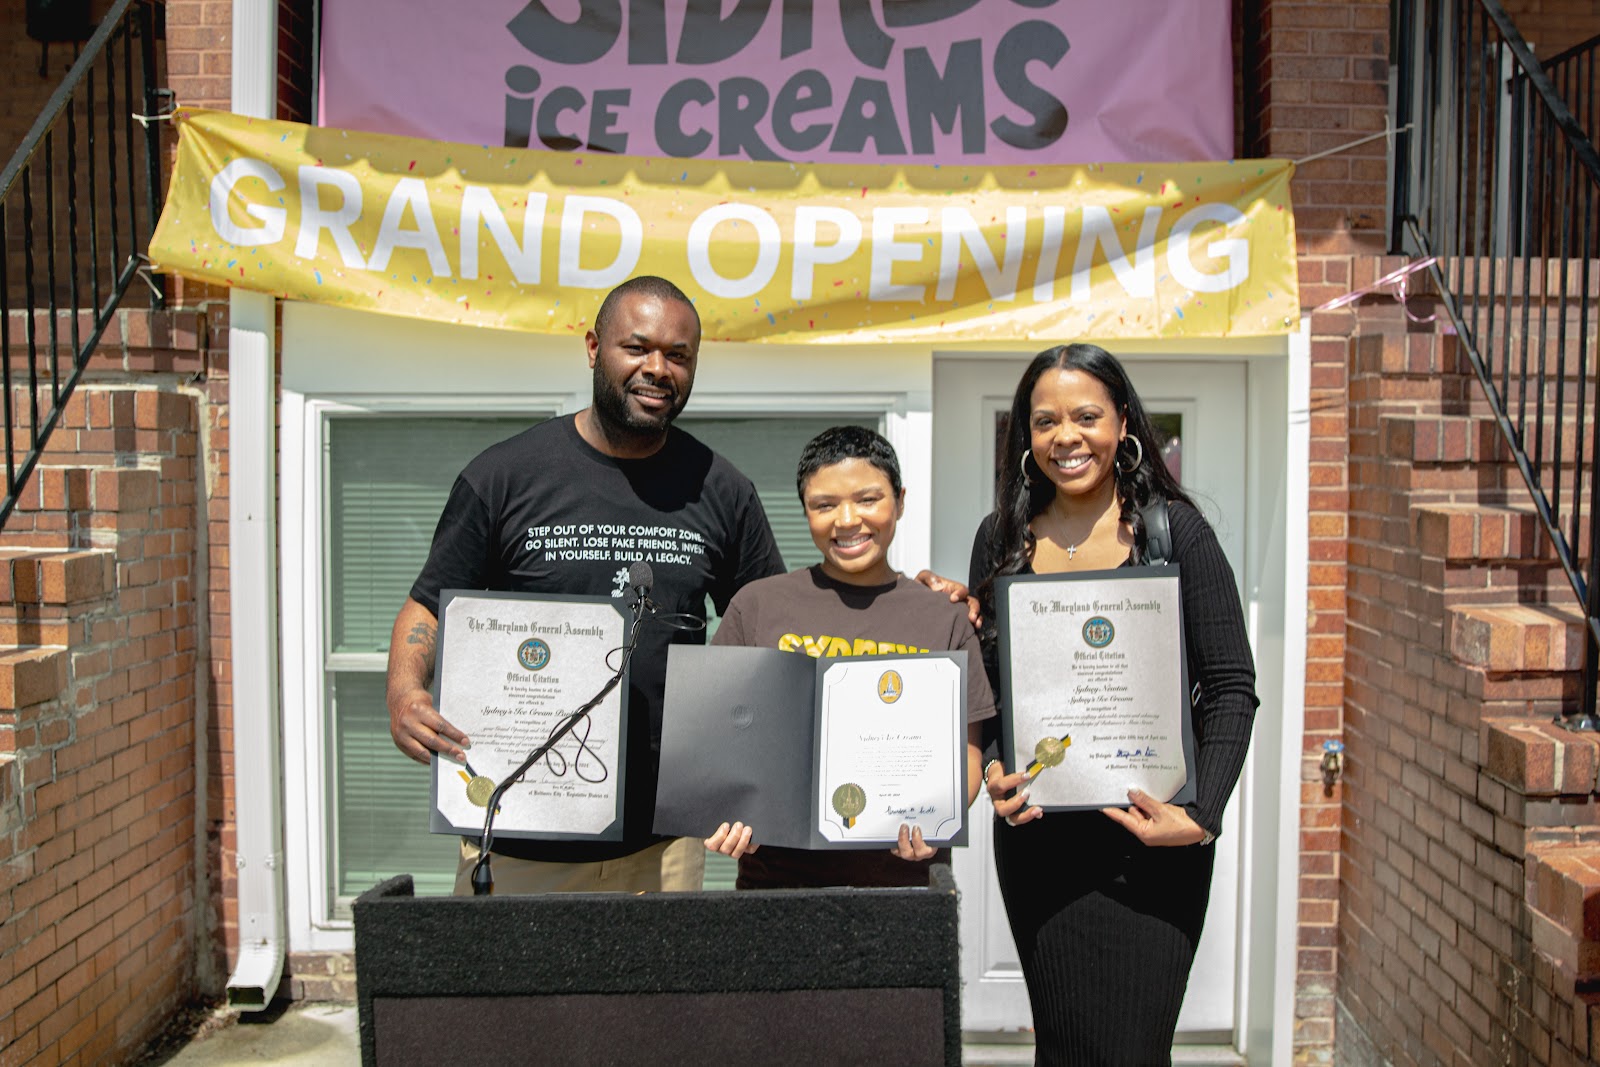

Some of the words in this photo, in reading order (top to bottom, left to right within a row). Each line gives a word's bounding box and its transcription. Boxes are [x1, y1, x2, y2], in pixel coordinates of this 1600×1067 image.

[210, 157, 643, 288] GRAND
[687, 202, 1249, 300] OPENING
[528, 526, 550, 538] STEP
[553, 525, 577, 536] OUT
[579, 524, 594, 534] OF
[597, 525, 626, 536] YOUR
[628, 526, 677, 538] COMFORT
[525, 539, 542, 551] GO
[544, 538, 580, 549] SILENT.
[583, 537, 609, 548] LOSE
[612, 538, 635, 549] FAKE
[638, 538, 679, 551] FRIENDS.
[682, 542, 706, 555] INVEST
[545, 551, 557, 562] IN
[559, 550, 612, 561] YOURSELF.
[614, 552, 644, 562] BUILD
[646, 552, 654, 562] A
[656, 554, 692, 566] LEGACY.
[1030, 600, 1048, 615] The
[1050, 600, 1090, 615] Maryland
[1092, 600, 1124, 614] General
[1125, 598, 1162, 615] Assembly
[466, 616, 485, 633] The
[486, 618, 528, 636] Maryland
[530, 621, 562, 636] General
[564, 622, 604, 640] Assembly
[480, 706, 512, 718] Sydney's
[529, 708, 553, 716] Cream
